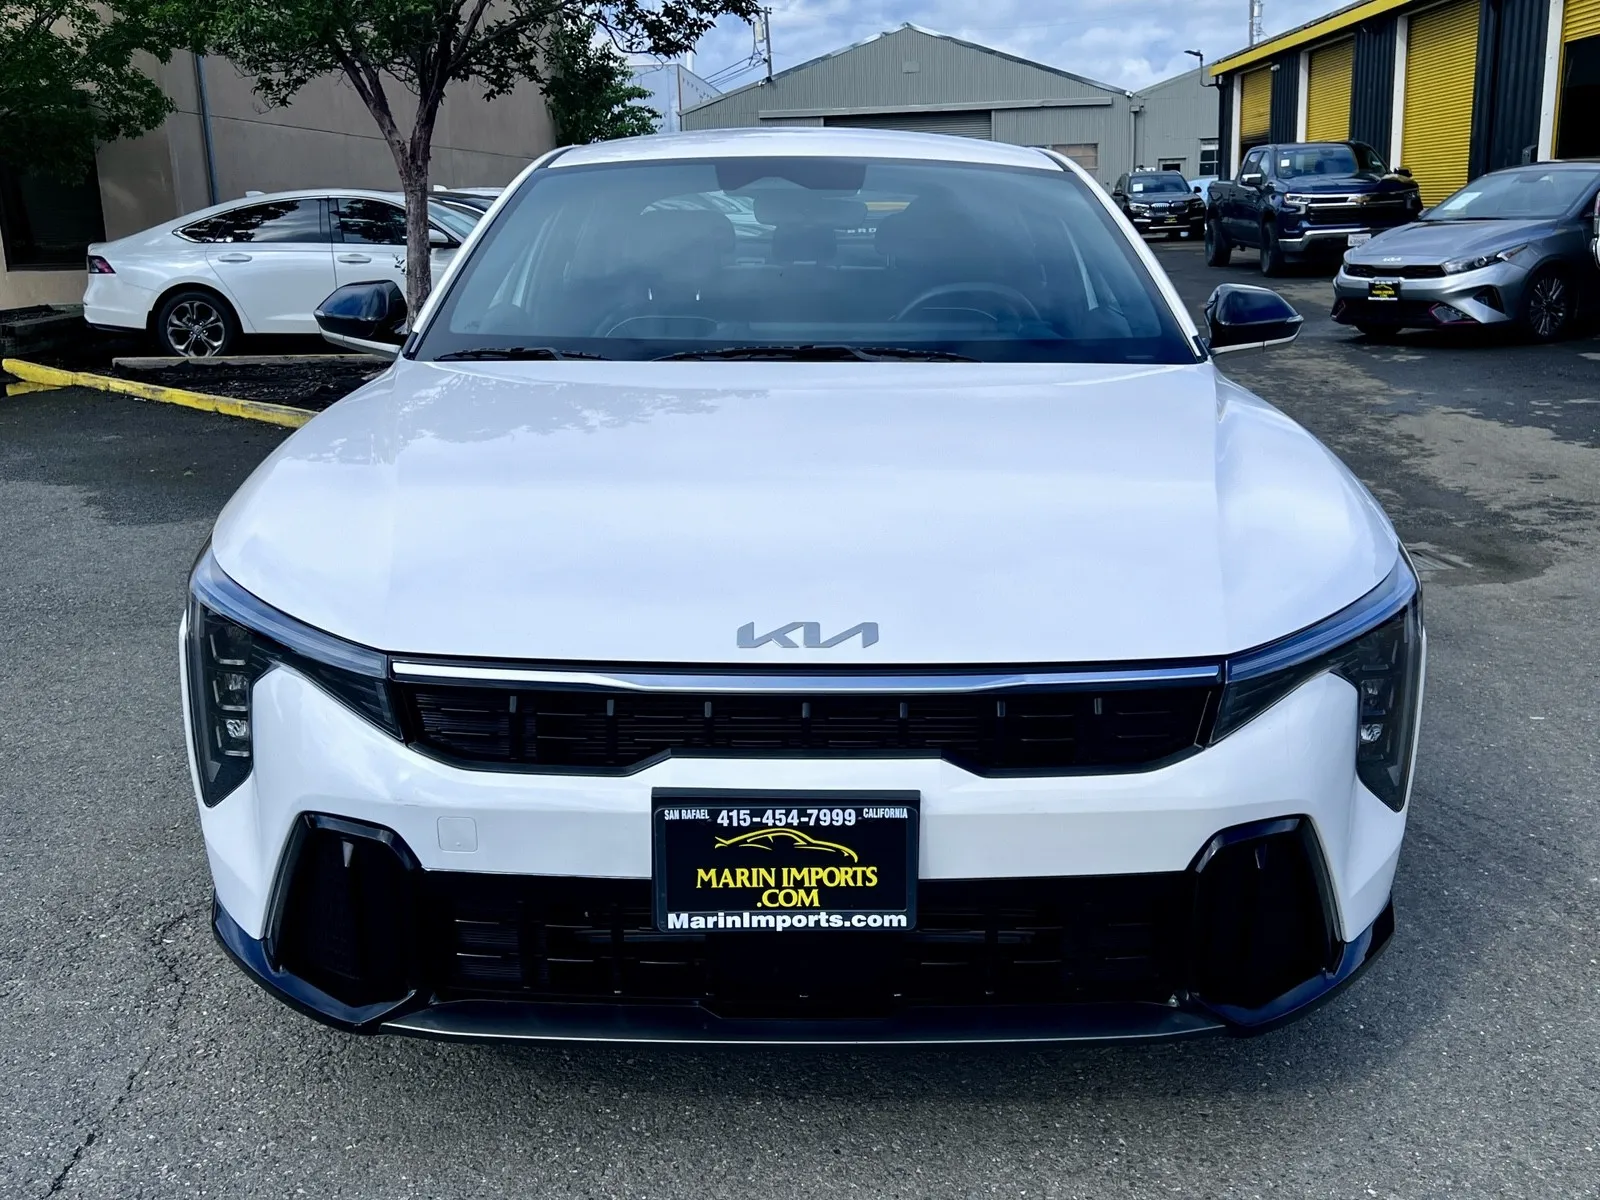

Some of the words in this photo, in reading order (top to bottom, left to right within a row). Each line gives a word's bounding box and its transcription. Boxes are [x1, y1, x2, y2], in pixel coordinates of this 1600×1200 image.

[737, 621, 879, 648] KIA
[664, 809, 680, 820] SAN
[681, 809, 710, 819] RAFAEL
[717, 809, 856, 827] 415-454-7999
[863, 807, 908, 819] CALIFORNIA
[696, 869, 776, 888] MARIN
[782, 867, 878, 887] IMPORTS
[756, 889, 820, 908] .COM
[667, 912, 907, 931] MarinImports.com
